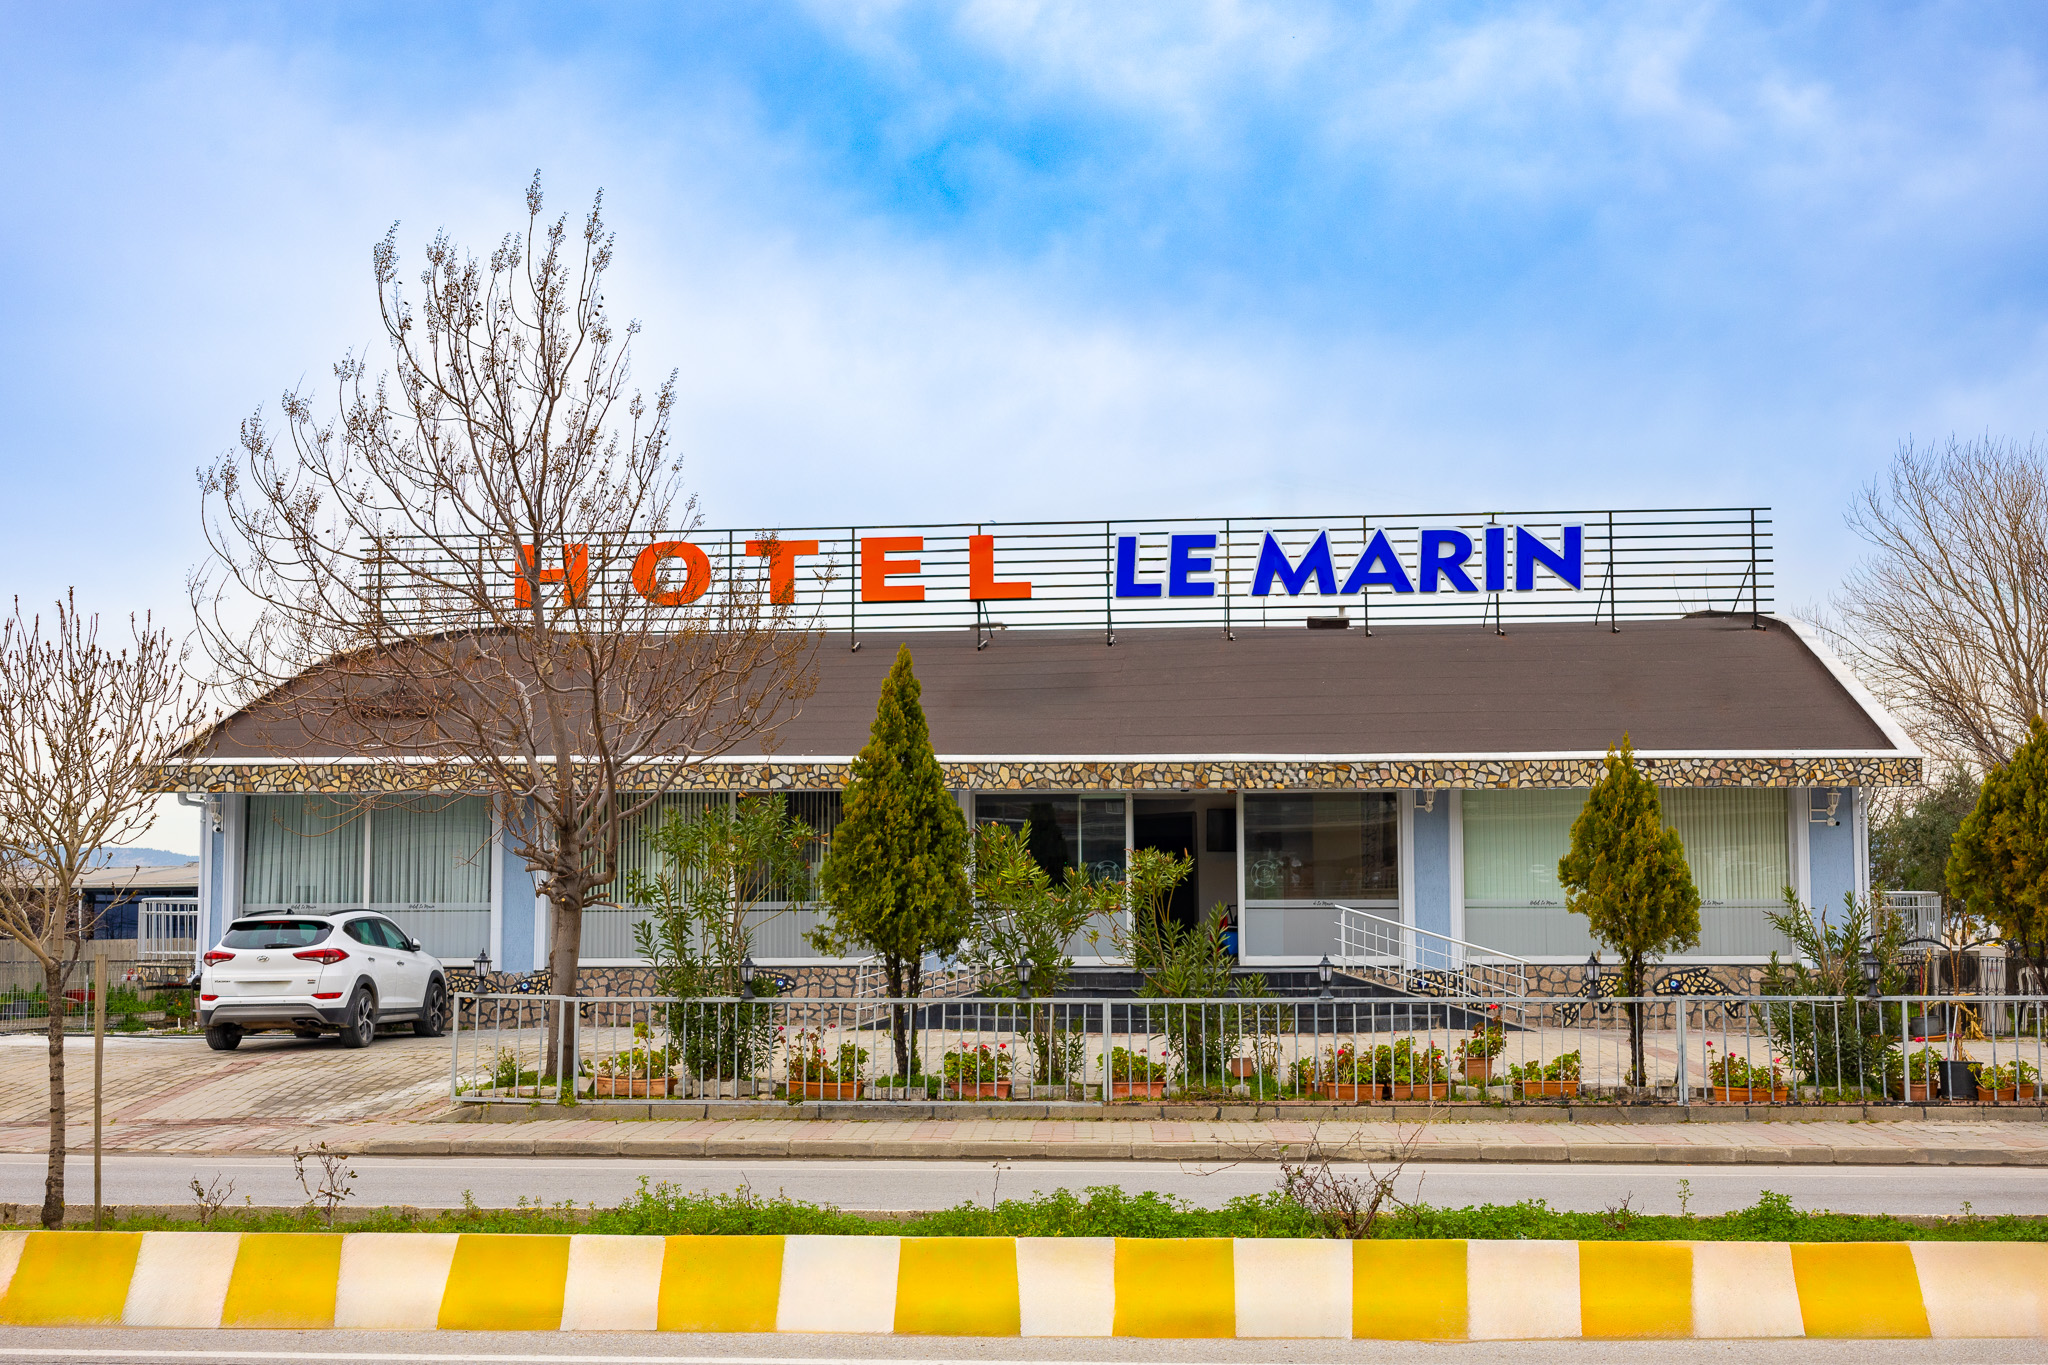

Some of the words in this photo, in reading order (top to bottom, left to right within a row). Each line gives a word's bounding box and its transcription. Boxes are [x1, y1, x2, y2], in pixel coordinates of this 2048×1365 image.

[514, 534, 1032, 608] HOTEL
[1115, 532, 1219, 598] LE
[1250, 524, 1583, 597] MARIN
